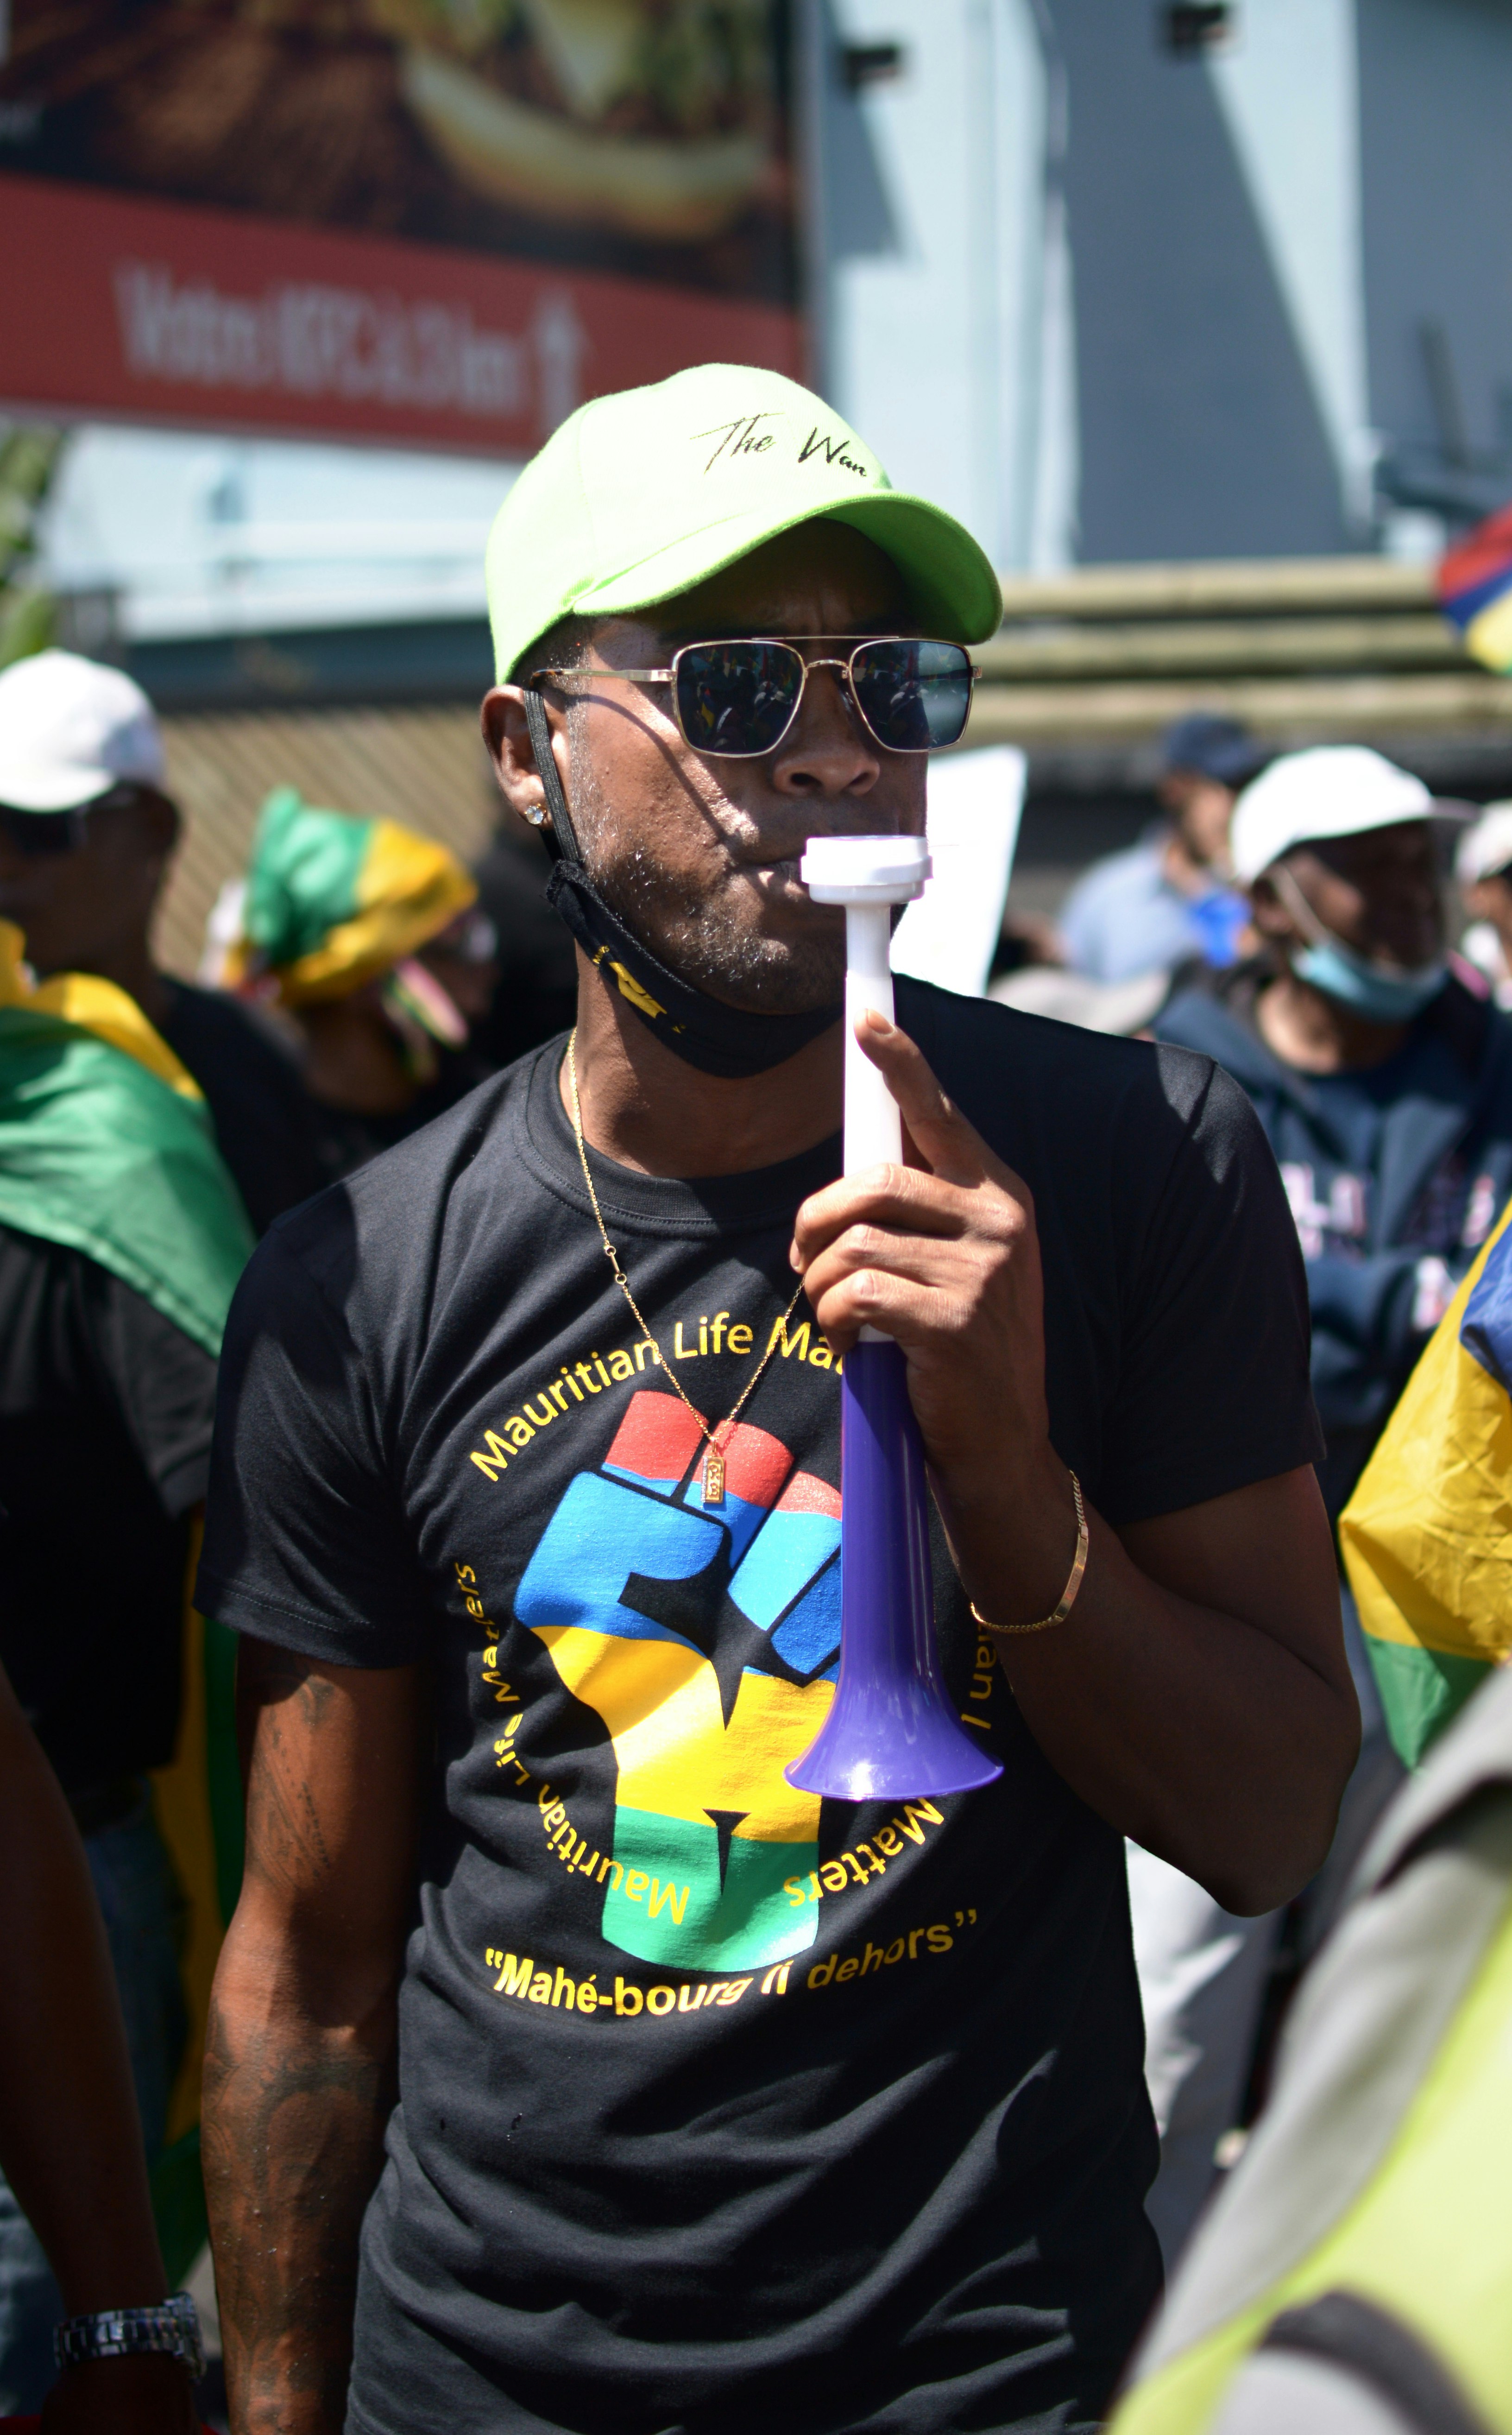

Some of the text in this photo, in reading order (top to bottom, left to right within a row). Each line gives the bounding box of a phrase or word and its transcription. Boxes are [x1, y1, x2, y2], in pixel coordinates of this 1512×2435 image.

[689, 412, 784, 474] The
[470, 1340, 661, 1482] Mauritian
[674, 1312, 754, 1359] Life
[494, 1714, 531, 1786] Life
[538, 1784, 690, 1925] Mauritian
[783, 1797, 945, 1907] Matters
